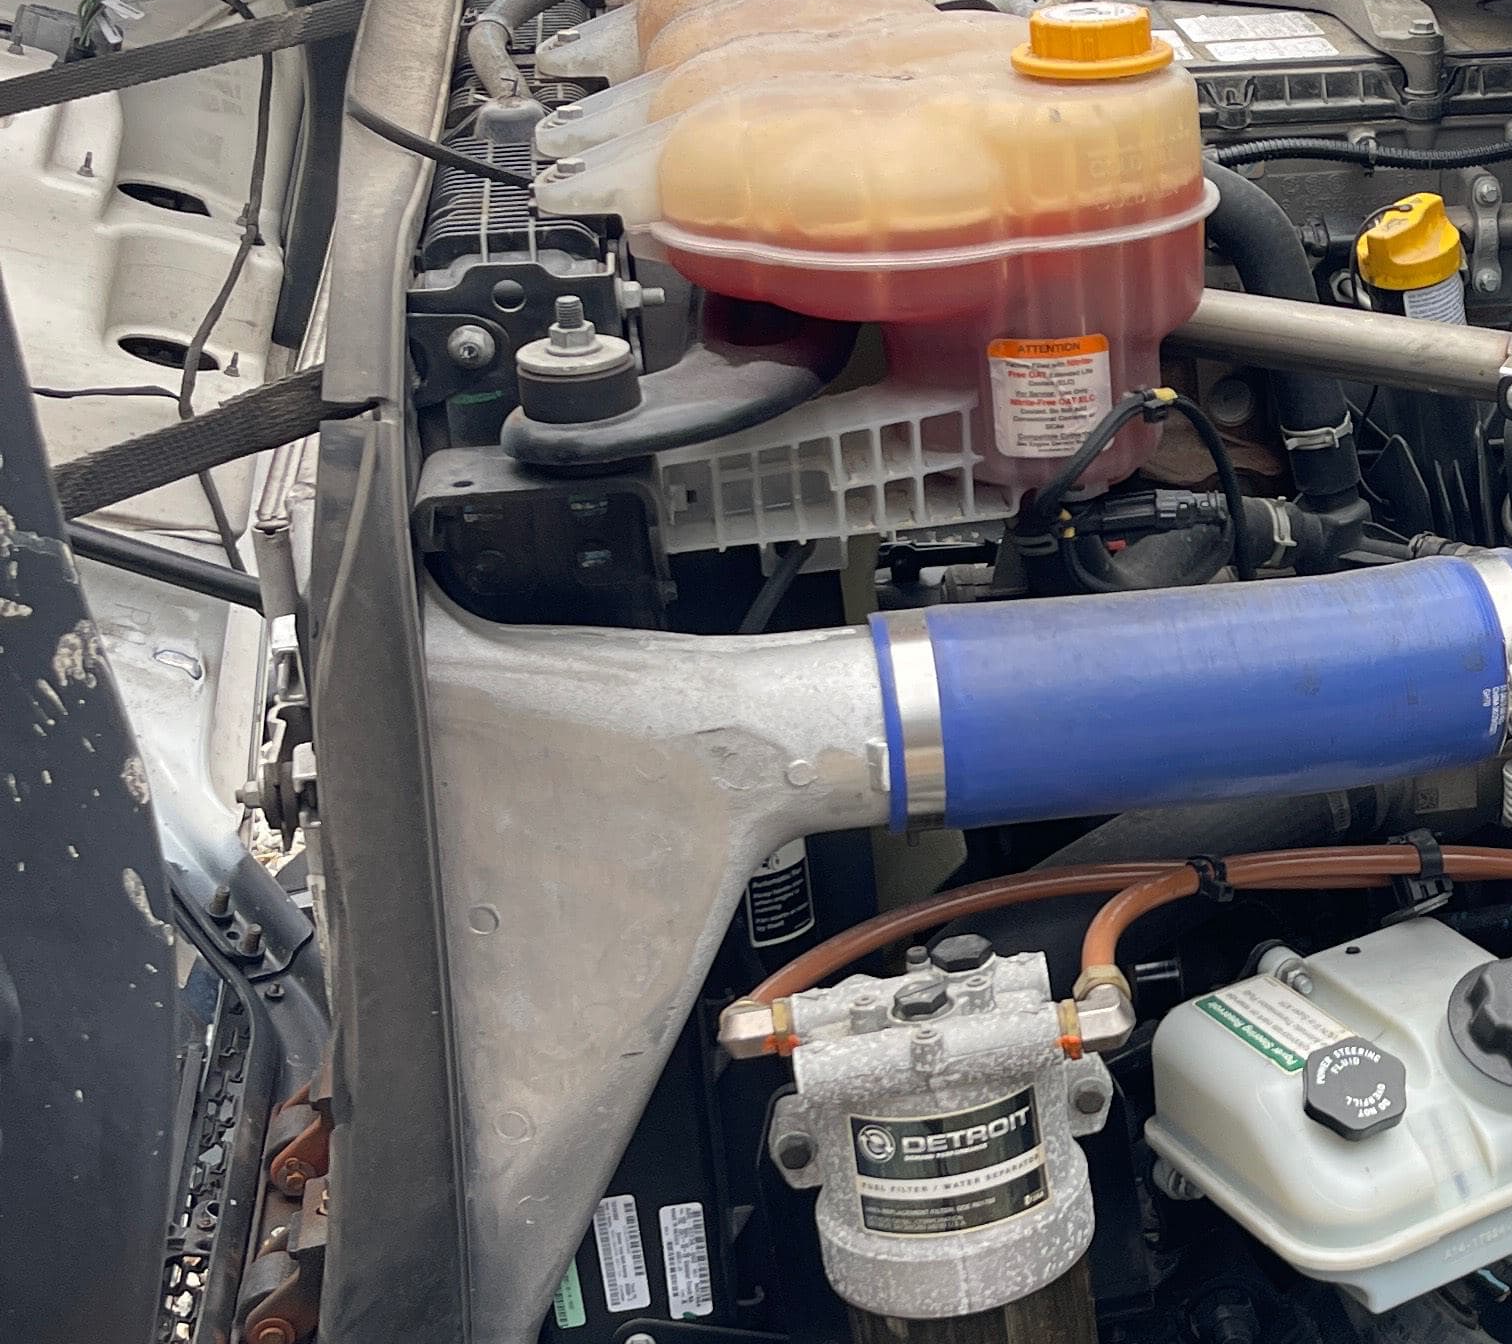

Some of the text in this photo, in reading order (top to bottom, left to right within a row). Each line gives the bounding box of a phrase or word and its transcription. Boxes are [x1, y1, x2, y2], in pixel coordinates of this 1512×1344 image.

[1018, 343, 1081, 353] ATTENTION
[1316, 1046, 1381, 1084] POWER STEERING
[1330, 1057, 1360, 1074] FLUID
[1357, 1098, 1391, 1118] DO NOT
[901, 1106, 1030, 1154] DETROIT
[861, 1181, 886, 1193] FUEL
[890, 1183, 929, 1193] FILTER
[944, 1176, 981, 1192] WATER
